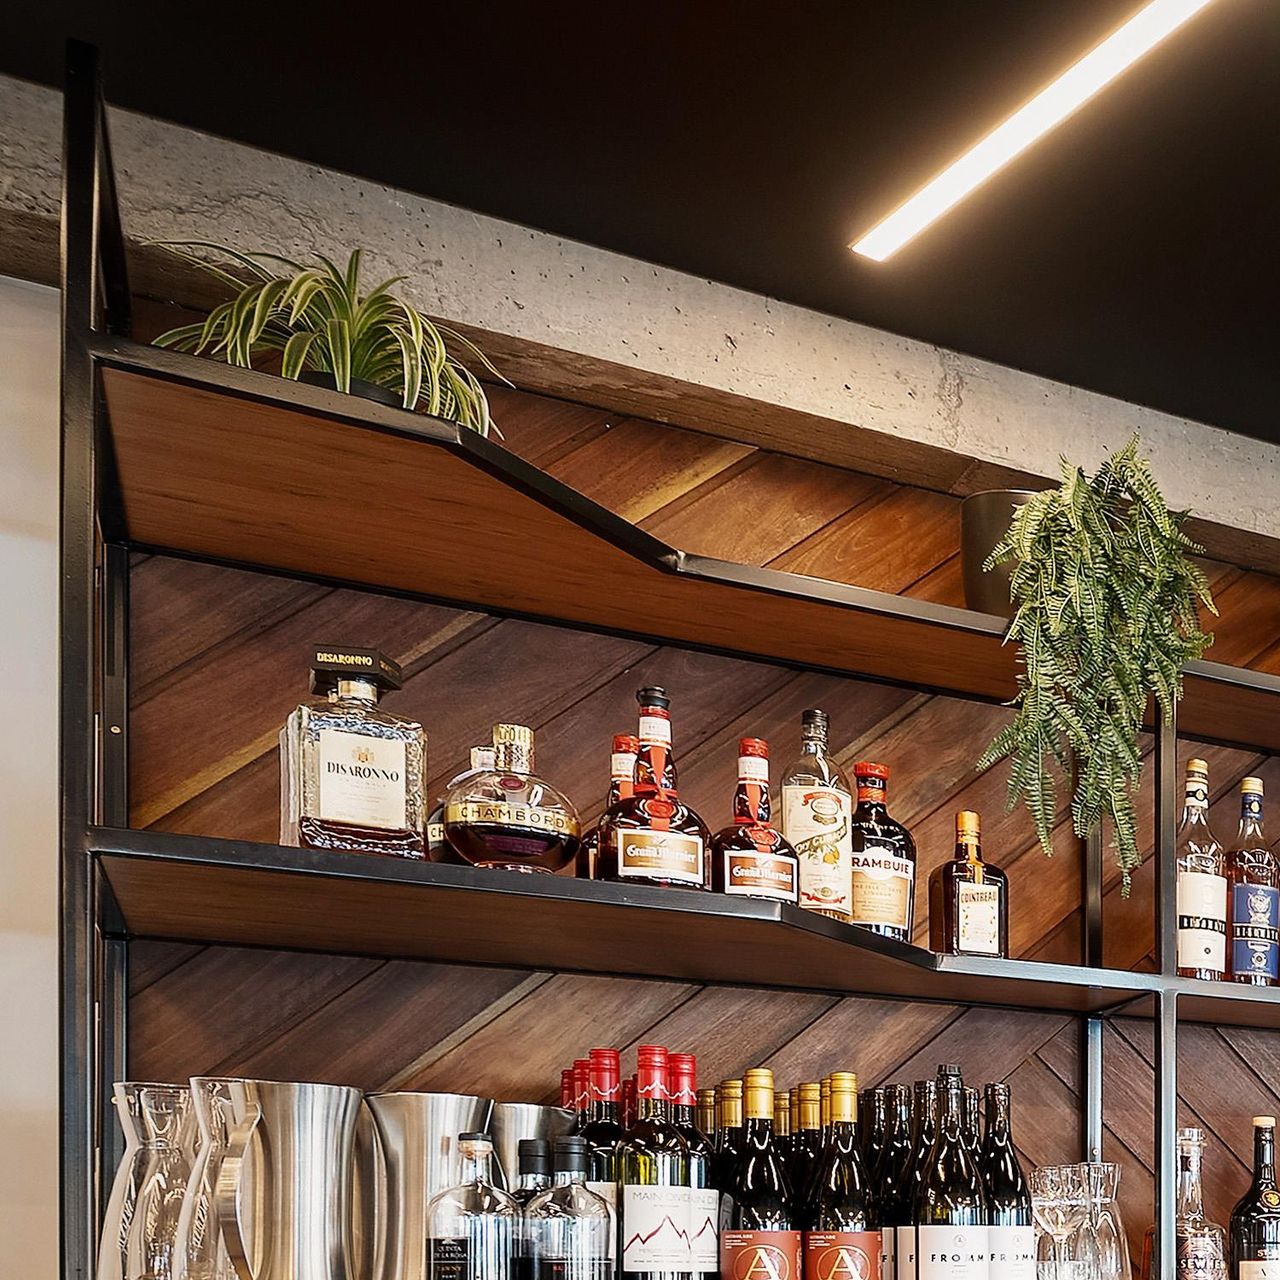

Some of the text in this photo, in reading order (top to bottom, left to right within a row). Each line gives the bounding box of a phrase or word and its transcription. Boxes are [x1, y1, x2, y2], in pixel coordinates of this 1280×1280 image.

[317, 652, 373, 666] DISARONNO
[327, 761, 399, 783] DISARONNO
[461, 805, 565, 829] CHAMBORD
[852, 856, 910, 875] RAMBUIE
[632, 1192, 658, 1201] MAIN
